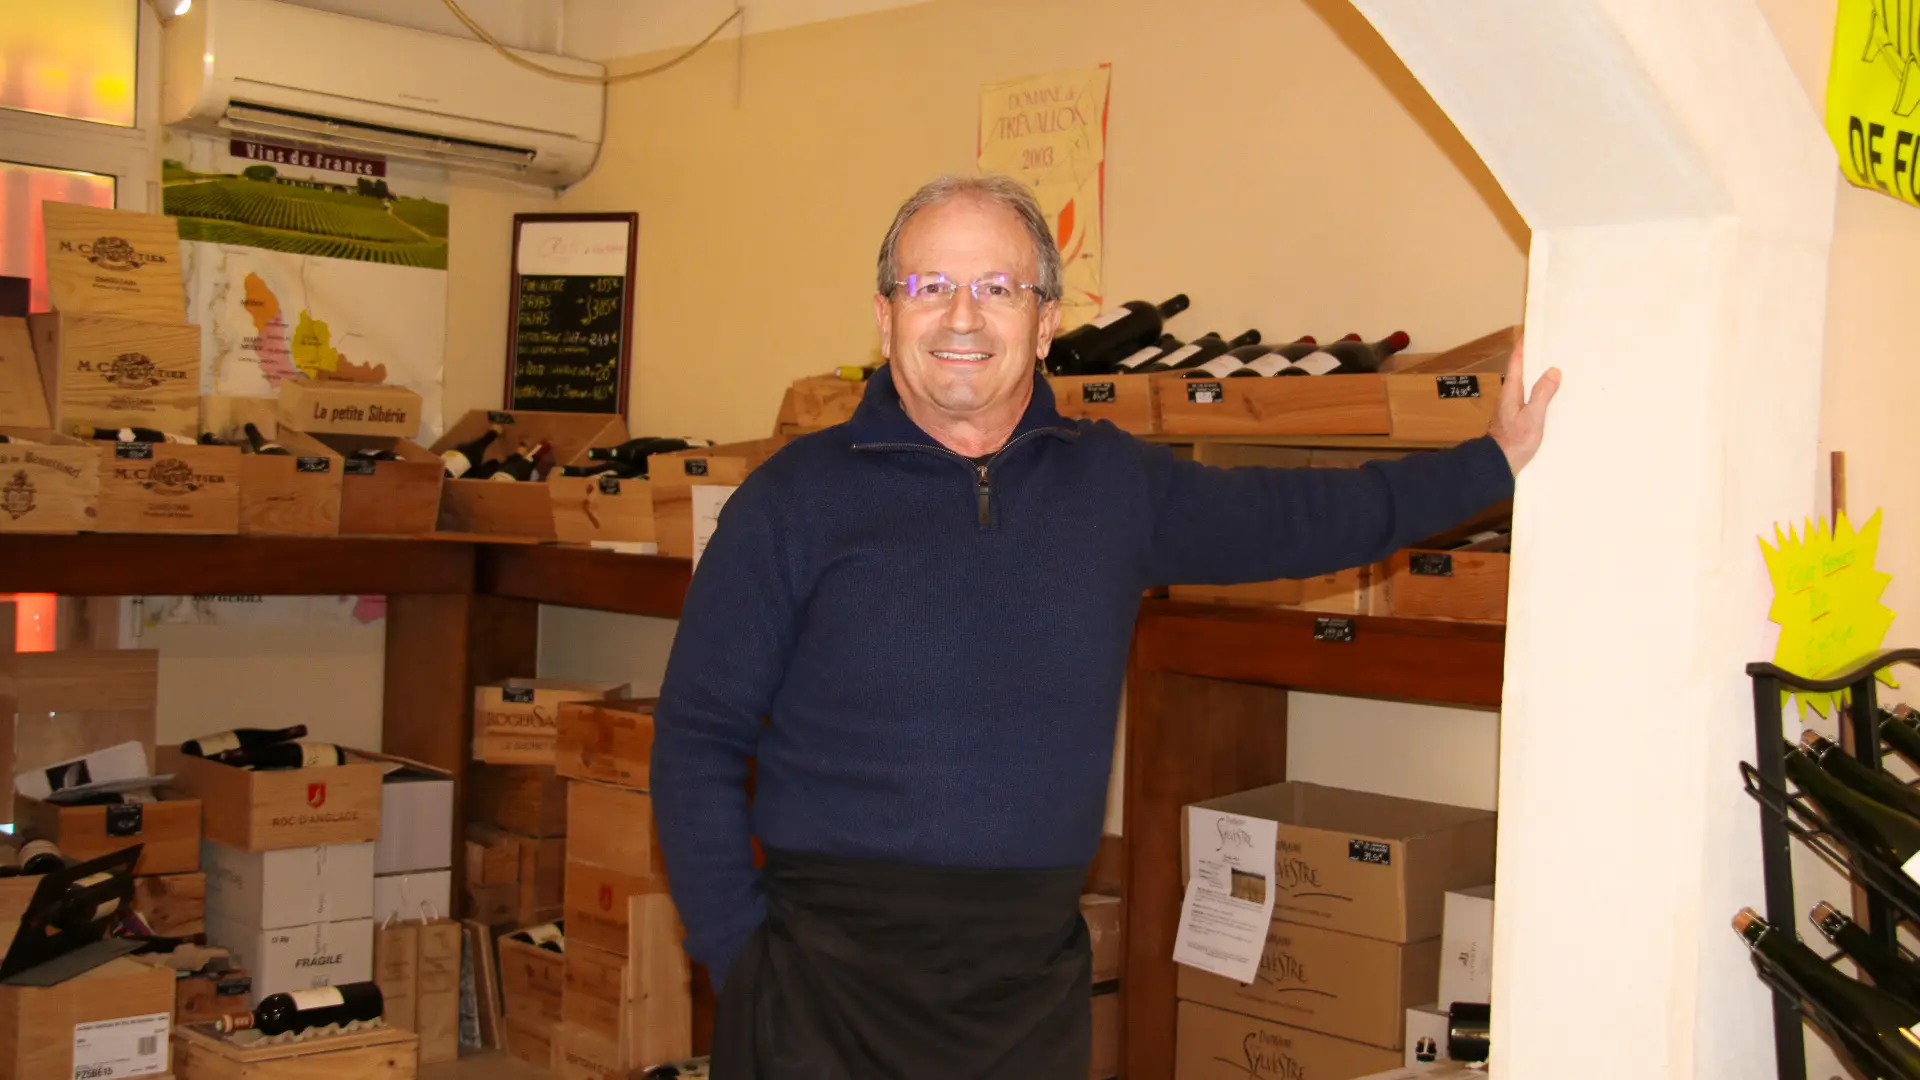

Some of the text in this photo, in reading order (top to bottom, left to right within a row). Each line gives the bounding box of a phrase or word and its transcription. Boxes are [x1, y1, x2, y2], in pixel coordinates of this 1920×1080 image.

[245, 142, 373, 175] Vins de France
[1021, 146, 1054, 170] 2003
[1849, 115, 1891, 194] DE
[314, 401, 406, 424] La petite Sibérie
[294, 953, 343, 968] FRAGILE
